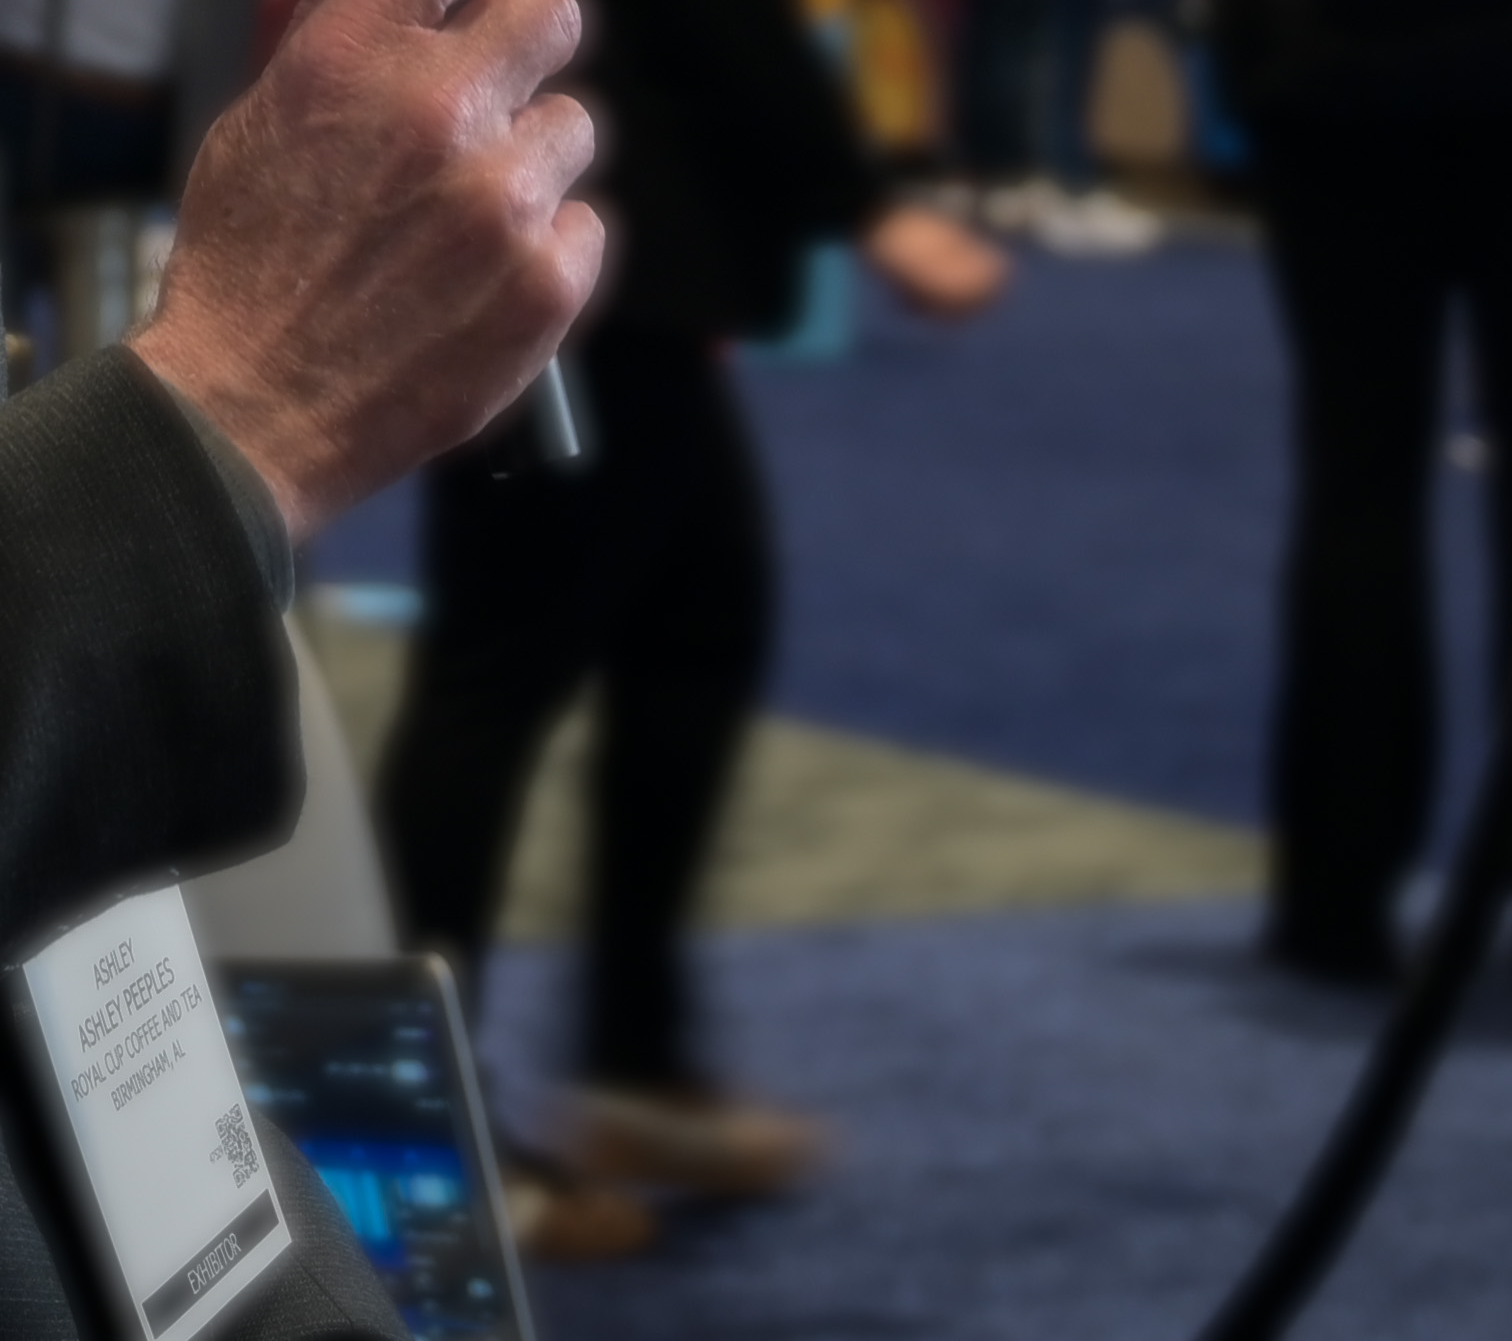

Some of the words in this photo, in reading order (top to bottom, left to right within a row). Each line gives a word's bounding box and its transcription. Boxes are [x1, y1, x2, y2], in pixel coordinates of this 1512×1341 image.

[93, 937, 134, 990] ASHLEY
[78, 995, 124, 1053] ASHLEY
[123, 957, 175, 1015] PEEPLES
[71, 1061, 106, 1102] ROYAL
[104, 1044, 124, 1075] CUP
[124, 1014, 163, 1059] COFFEE
[160, 999, 182, 1033] AND
[180, 984, 202, 1013] TEA
[110, 1049, 174, 1111] BIRMINGHAM,
[172, 1039, 186, 1062] AL
[187, 1232, 242, 1295] EXHIBITOR
